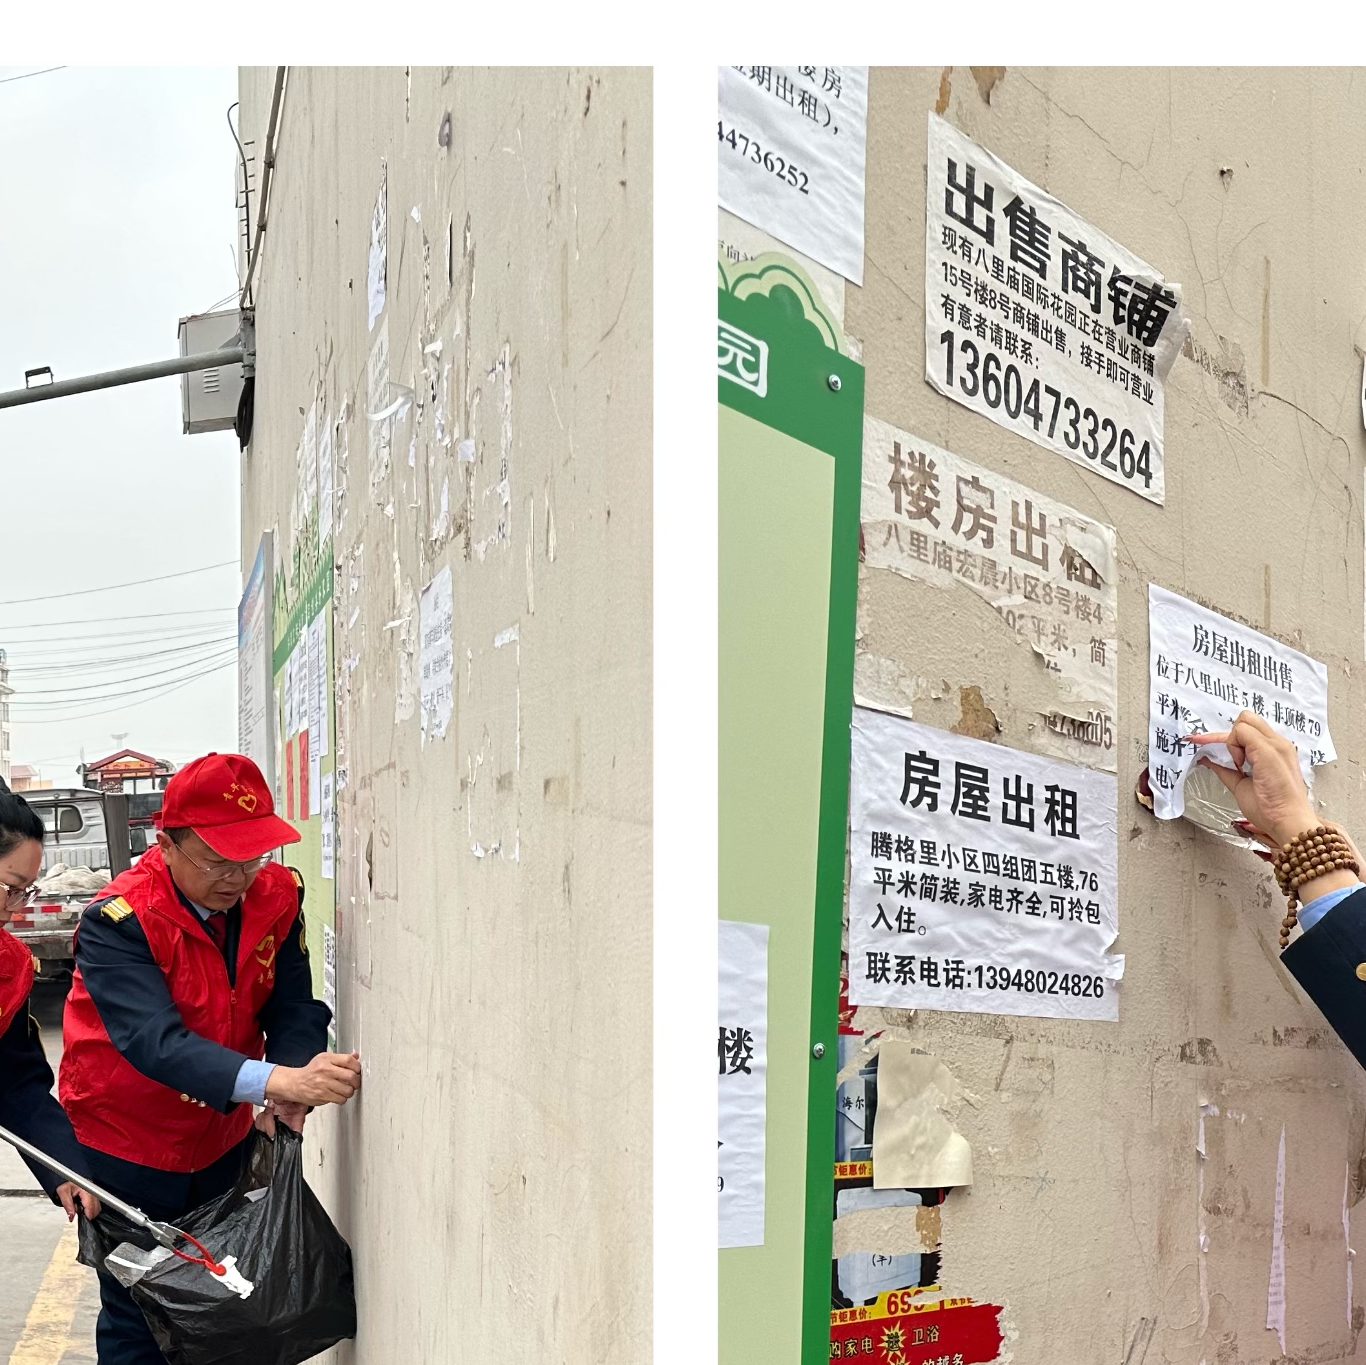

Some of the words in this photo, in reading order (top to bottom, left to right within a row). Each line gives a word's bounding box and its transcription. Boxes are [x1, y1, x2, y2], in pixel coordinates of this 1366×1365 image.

[945, 157, 1178, 348] 出售商铺
[942, 224, 1155, 378] 现有八里庙国际花园正在营业商铺
[940, 330, 1154, 489] 13604733264
[1192, 624, 1293, 693] 房屋出租出售
[898, 750, 1081, 840] 房屋出租
[871, 902, 928, 937] 入住。
[718, 1027, 754, 1075] 楼
[911, 1324, 941, 1347] 卫浴
